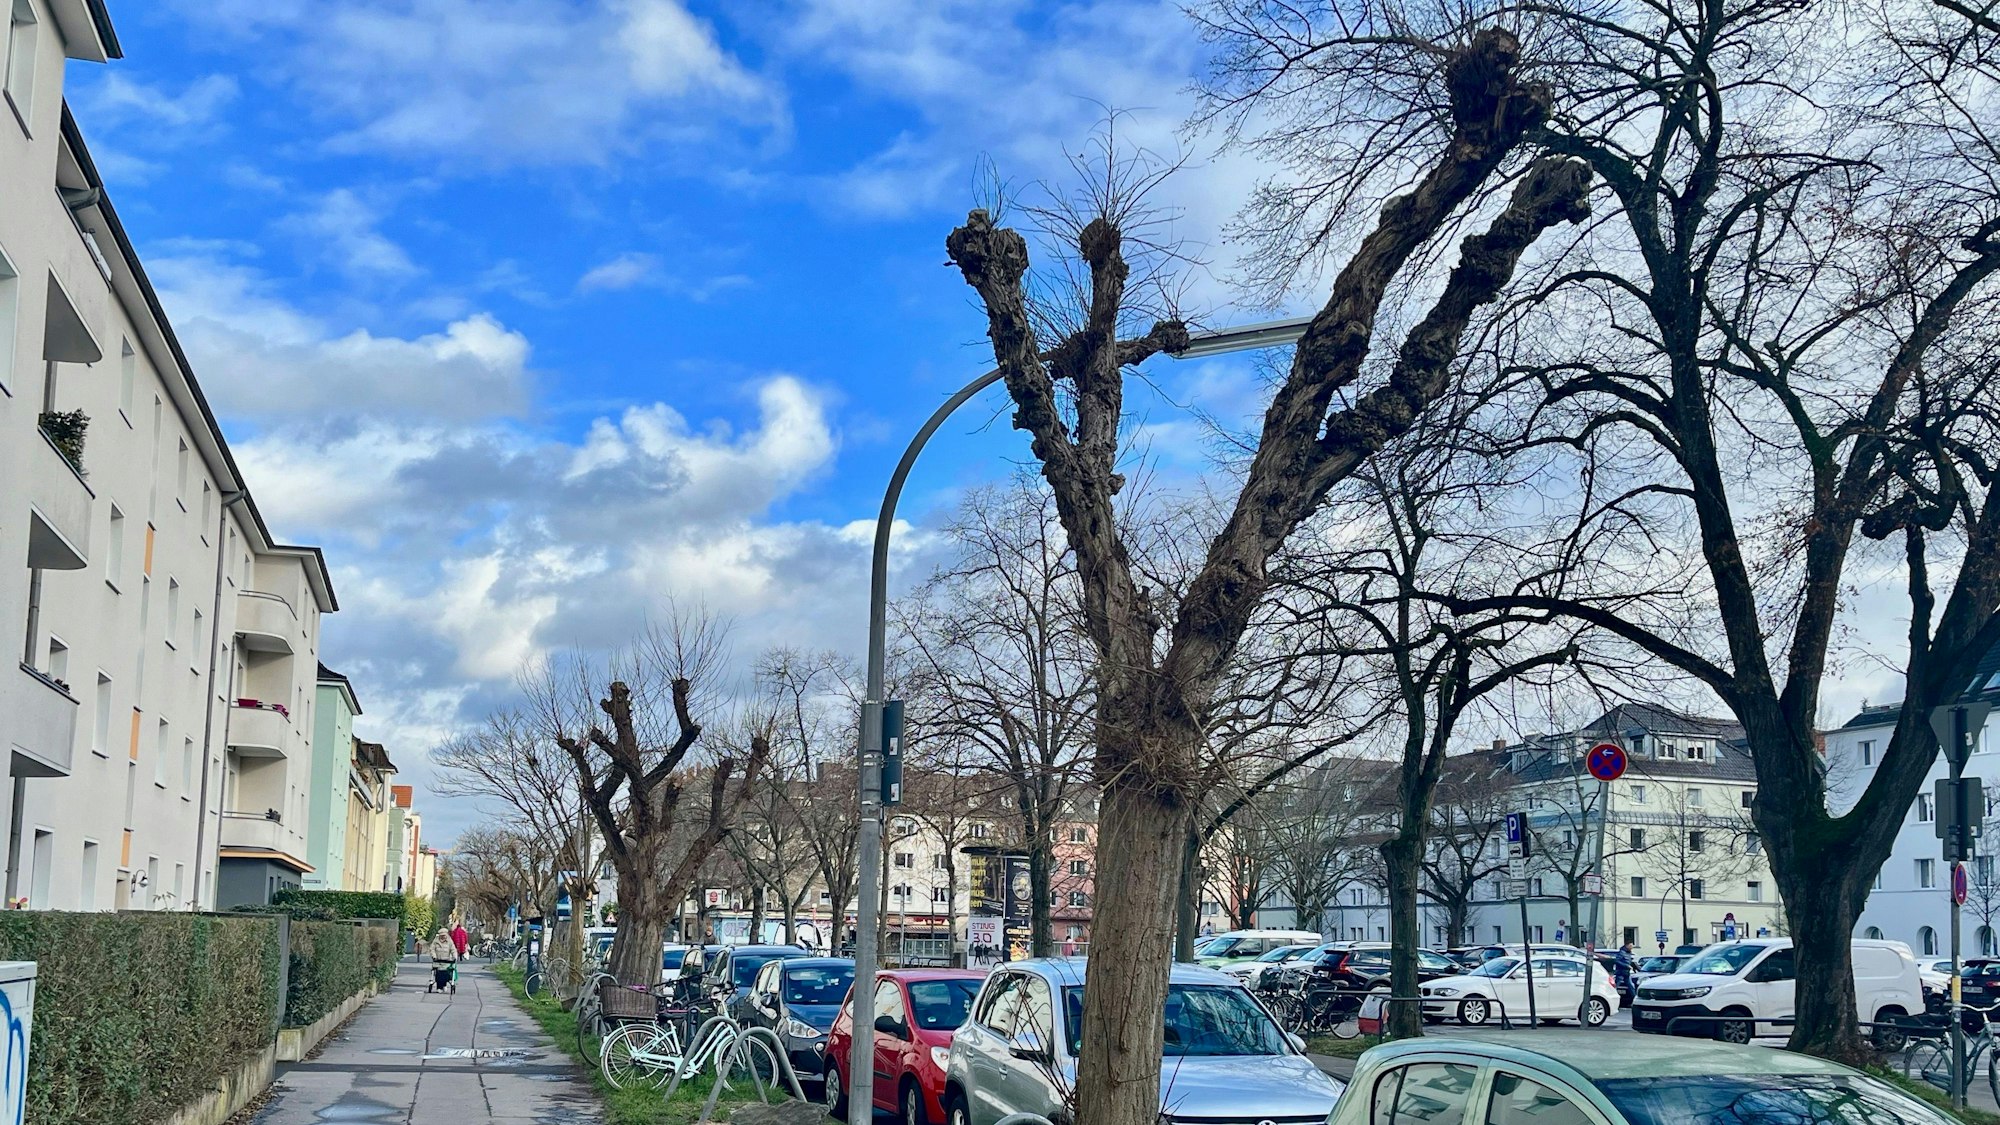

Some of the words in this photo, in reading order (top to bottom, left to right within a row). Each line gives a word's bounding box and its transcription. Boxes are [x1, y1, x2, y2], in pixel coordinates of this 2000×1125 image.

[1509, 816, 1517, 840] P
[971, 922, 996, 930] STING
[973, 932, 992, 943] 3.0
